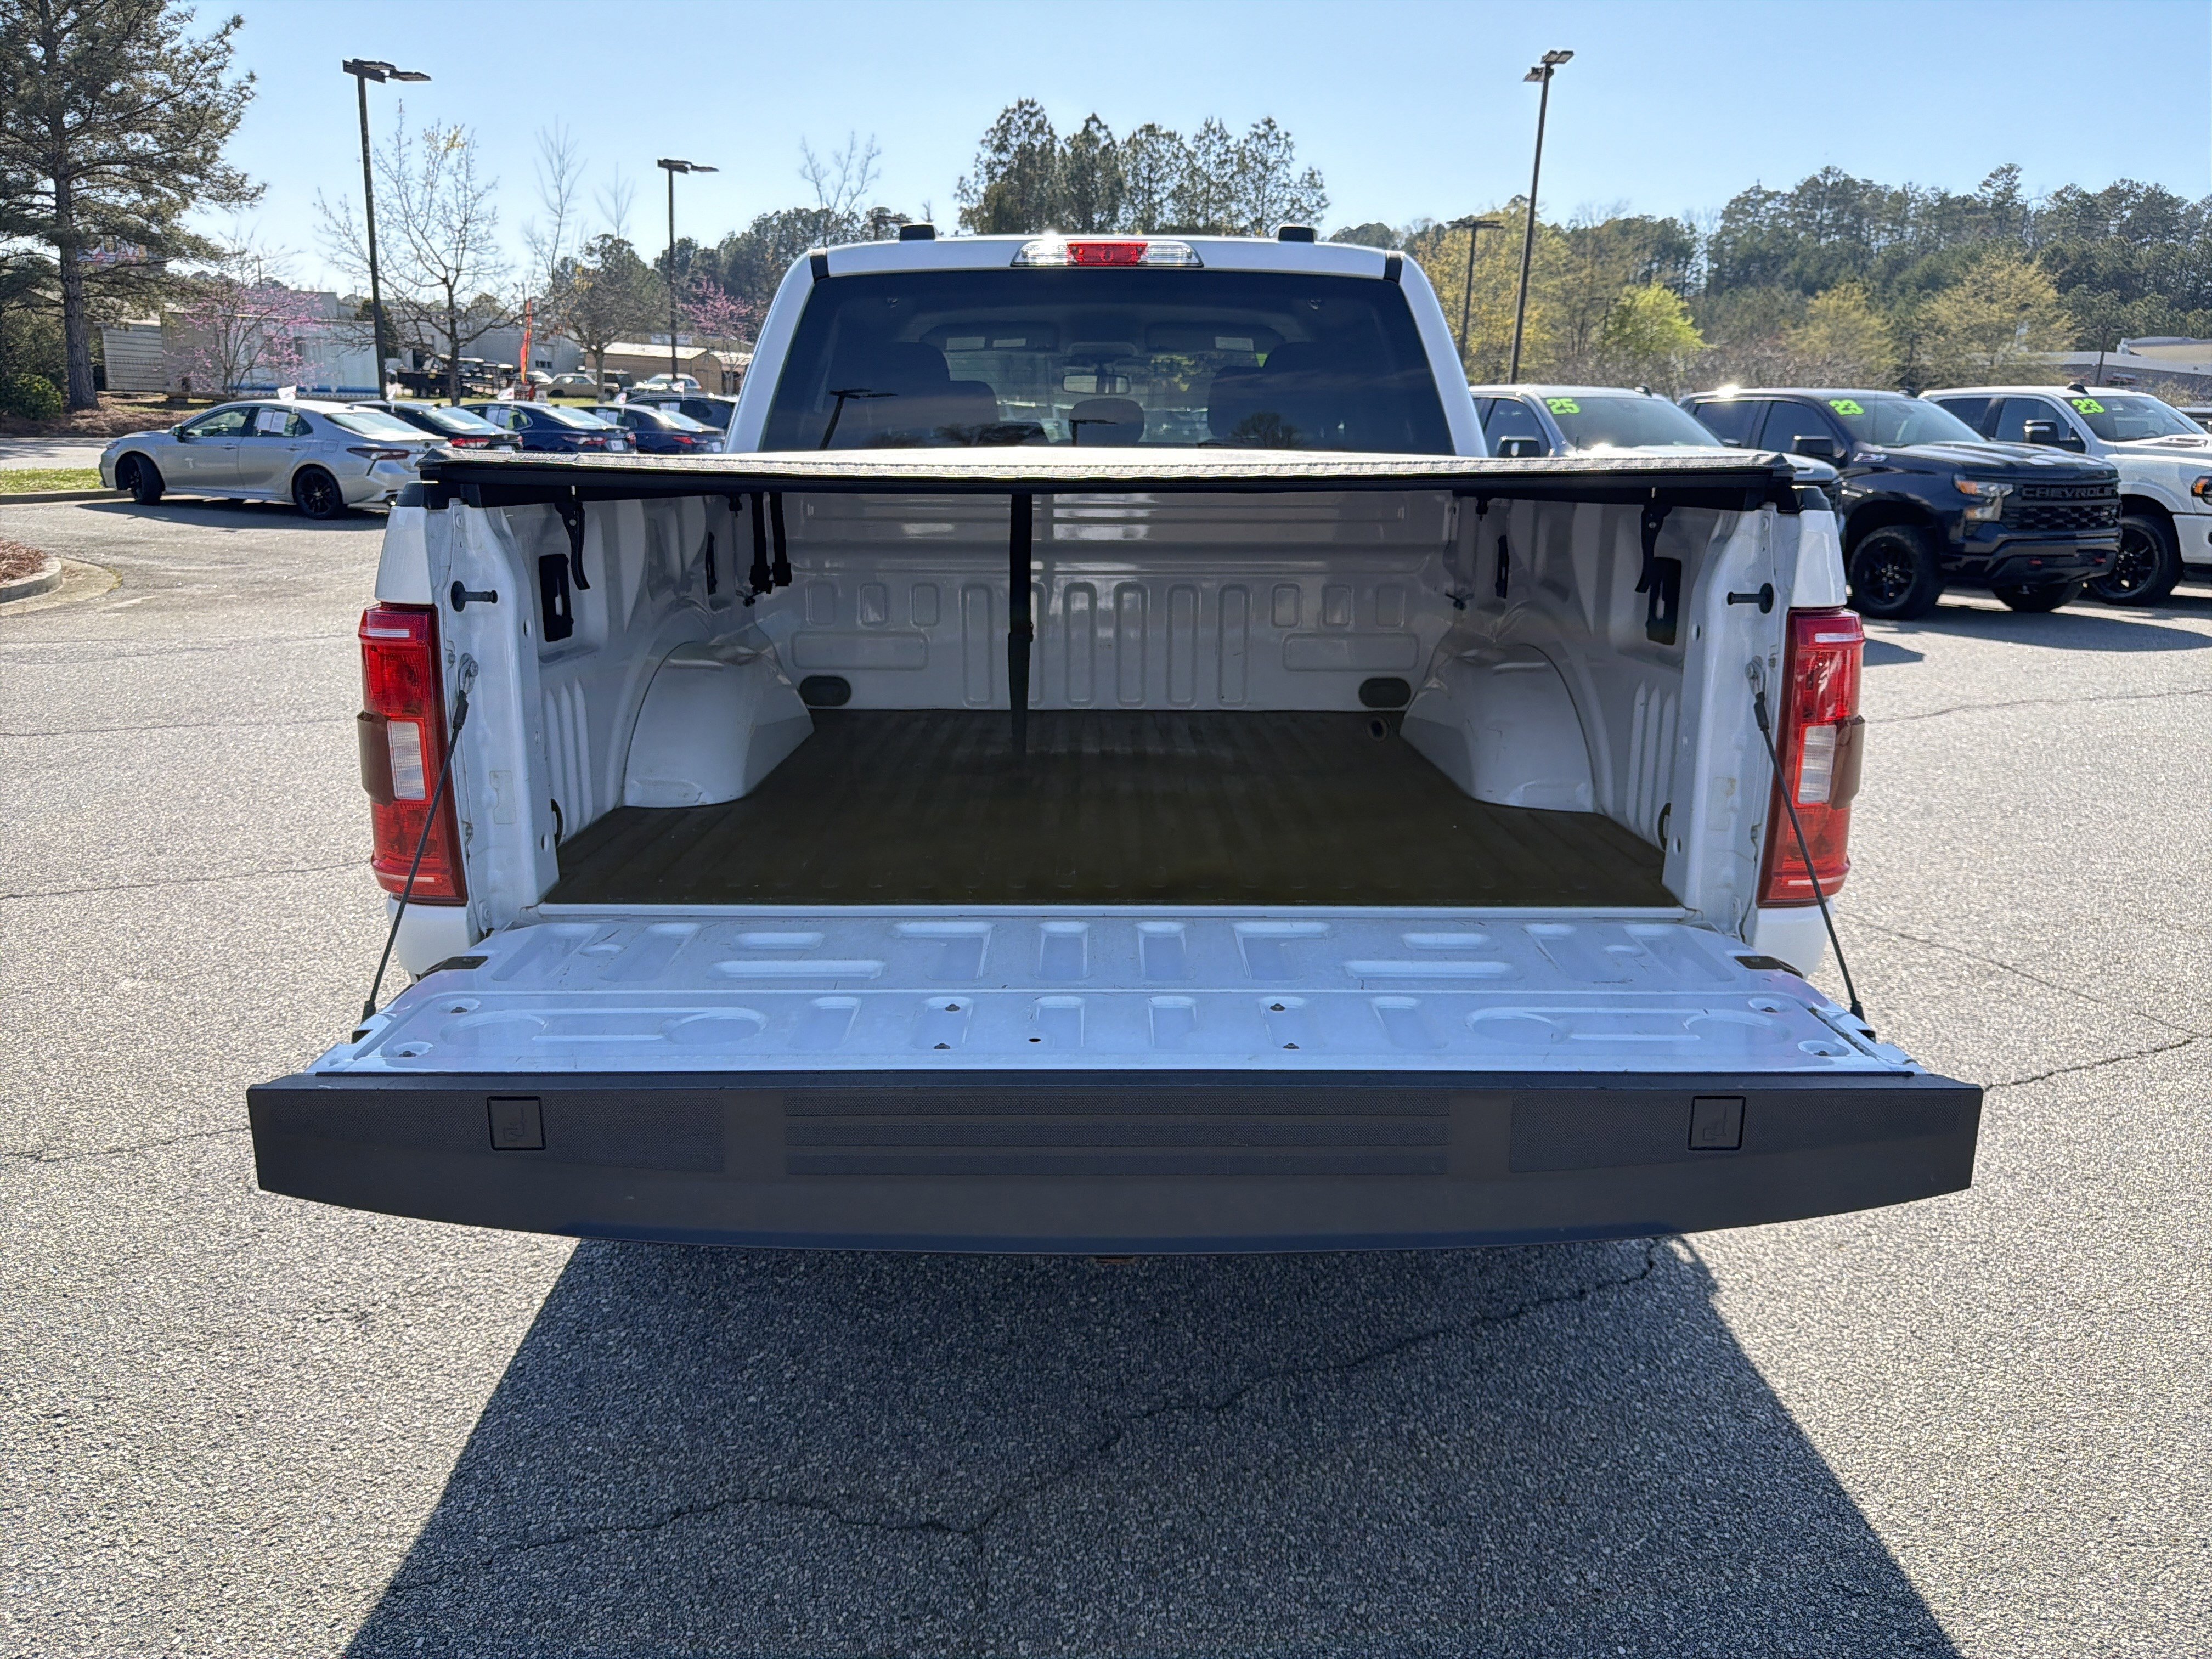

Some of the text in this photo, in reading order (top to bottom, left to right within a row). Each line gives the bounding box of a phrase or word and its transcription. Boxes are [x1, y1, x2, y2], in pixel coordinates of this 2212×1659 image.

[1546, 398, 1579, 414] 25
[1829, 399, 1864, 415] 23
[2071, 398, 2105, 414] 23
